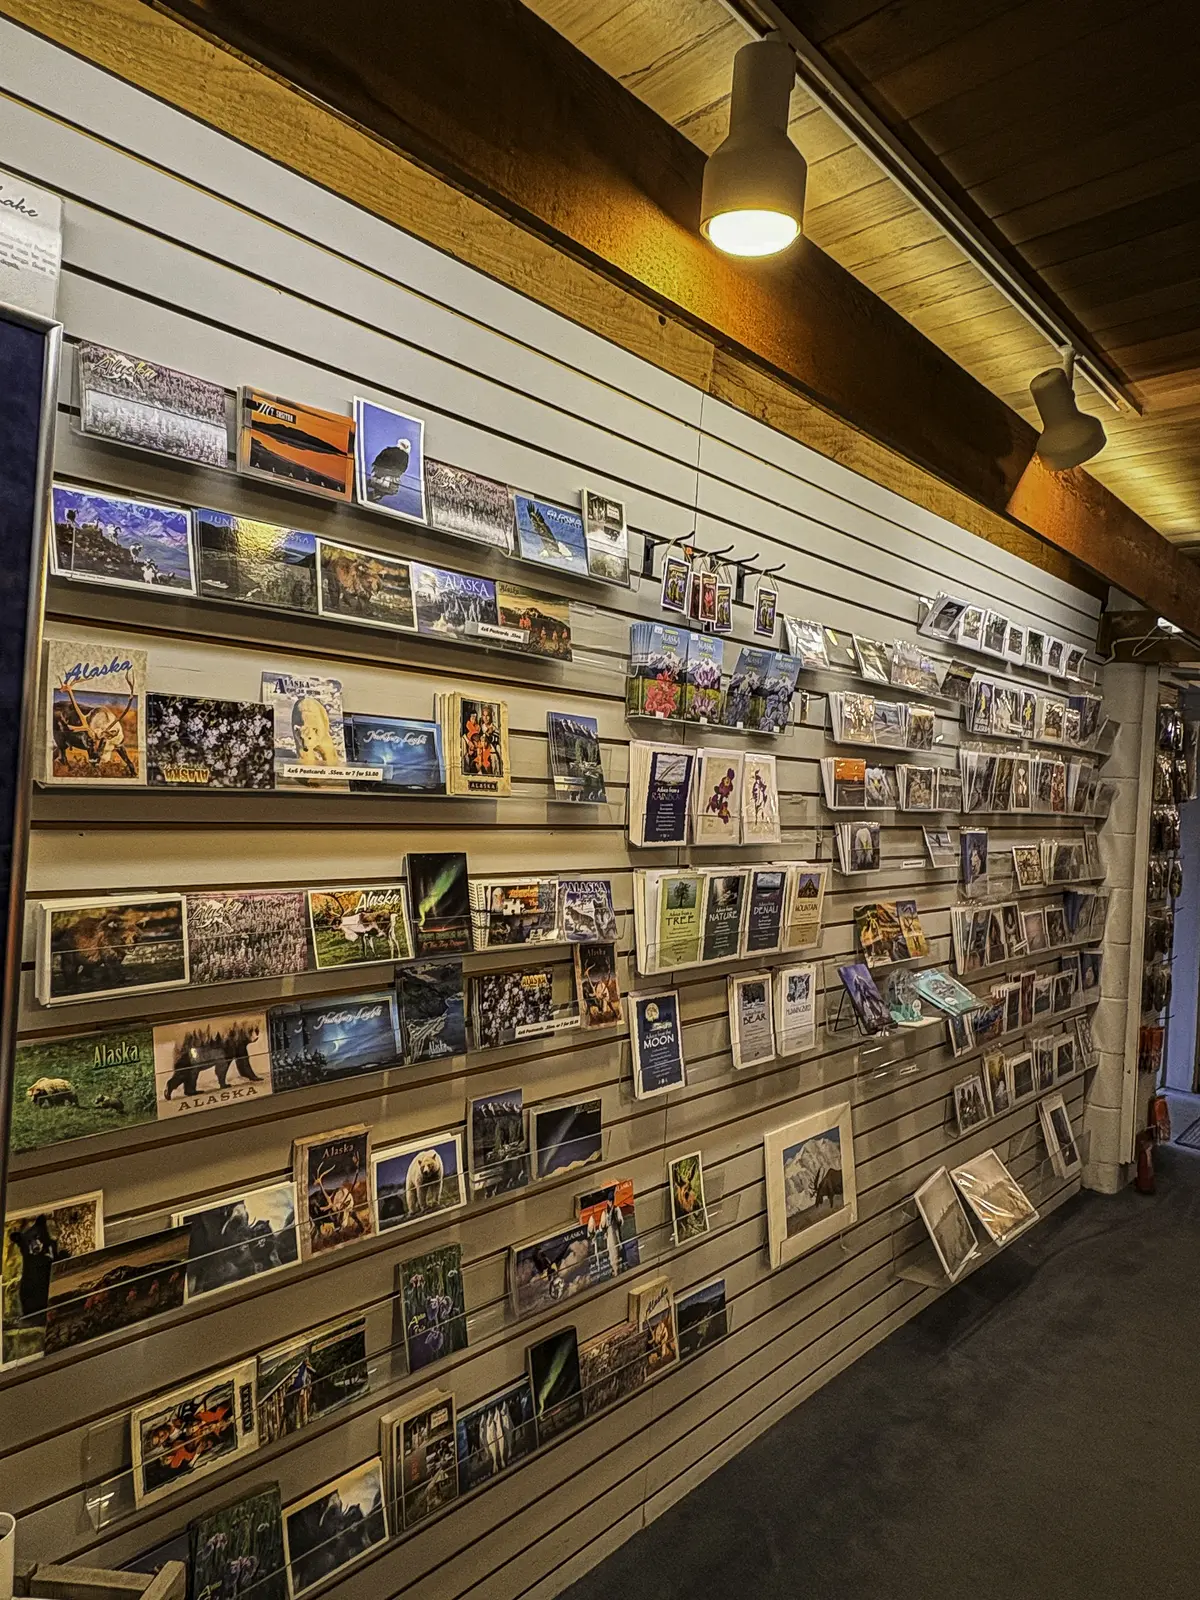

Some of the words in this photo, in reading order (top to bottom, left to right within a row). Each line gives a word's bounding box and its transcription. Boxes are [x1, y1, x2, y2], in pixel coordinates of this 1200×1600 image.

[0, 197, 39, 217] ake
[445, 575, 490, 598] ALASKA
[490, 628, 509, 637] Postcards
[660, 633, 681, 647] ALASKA
[64, 656, 133, 684] Alaska
[273, 677, 310, 695] ALASKA
[363, 729, 400, 745] Northern
[401, 731, 429, 746] Lights
[163, 766, 211, 784] ALASKA
[470, 782, 496, 790] ALASKA
[568, 882, 607, 893] ALASKA
[355, 889, 400, 913] Alaska
[188, 898, 244, 922] Alaska
[709, 910, 738, 921] NATURE
[753, 905, 779, 915] DENALI
[665, 915, 696, 926] TREE
[521, 974, 547, 987] ALASKA
[313, 1010, 353, 1031] Northern
[743, 1013, 767, 1026] BEAR
[644, 1034, 675, 1050] MOON
[92, 1040, 141, 1070] Alaska
[178, 1086, 259, 1112] ALASKA
[321, 1142, 355, 1161] Alaska
[563, 1230, 585, 1242] ALASKA
[242, 1386, 252, 1429] ALASKA
